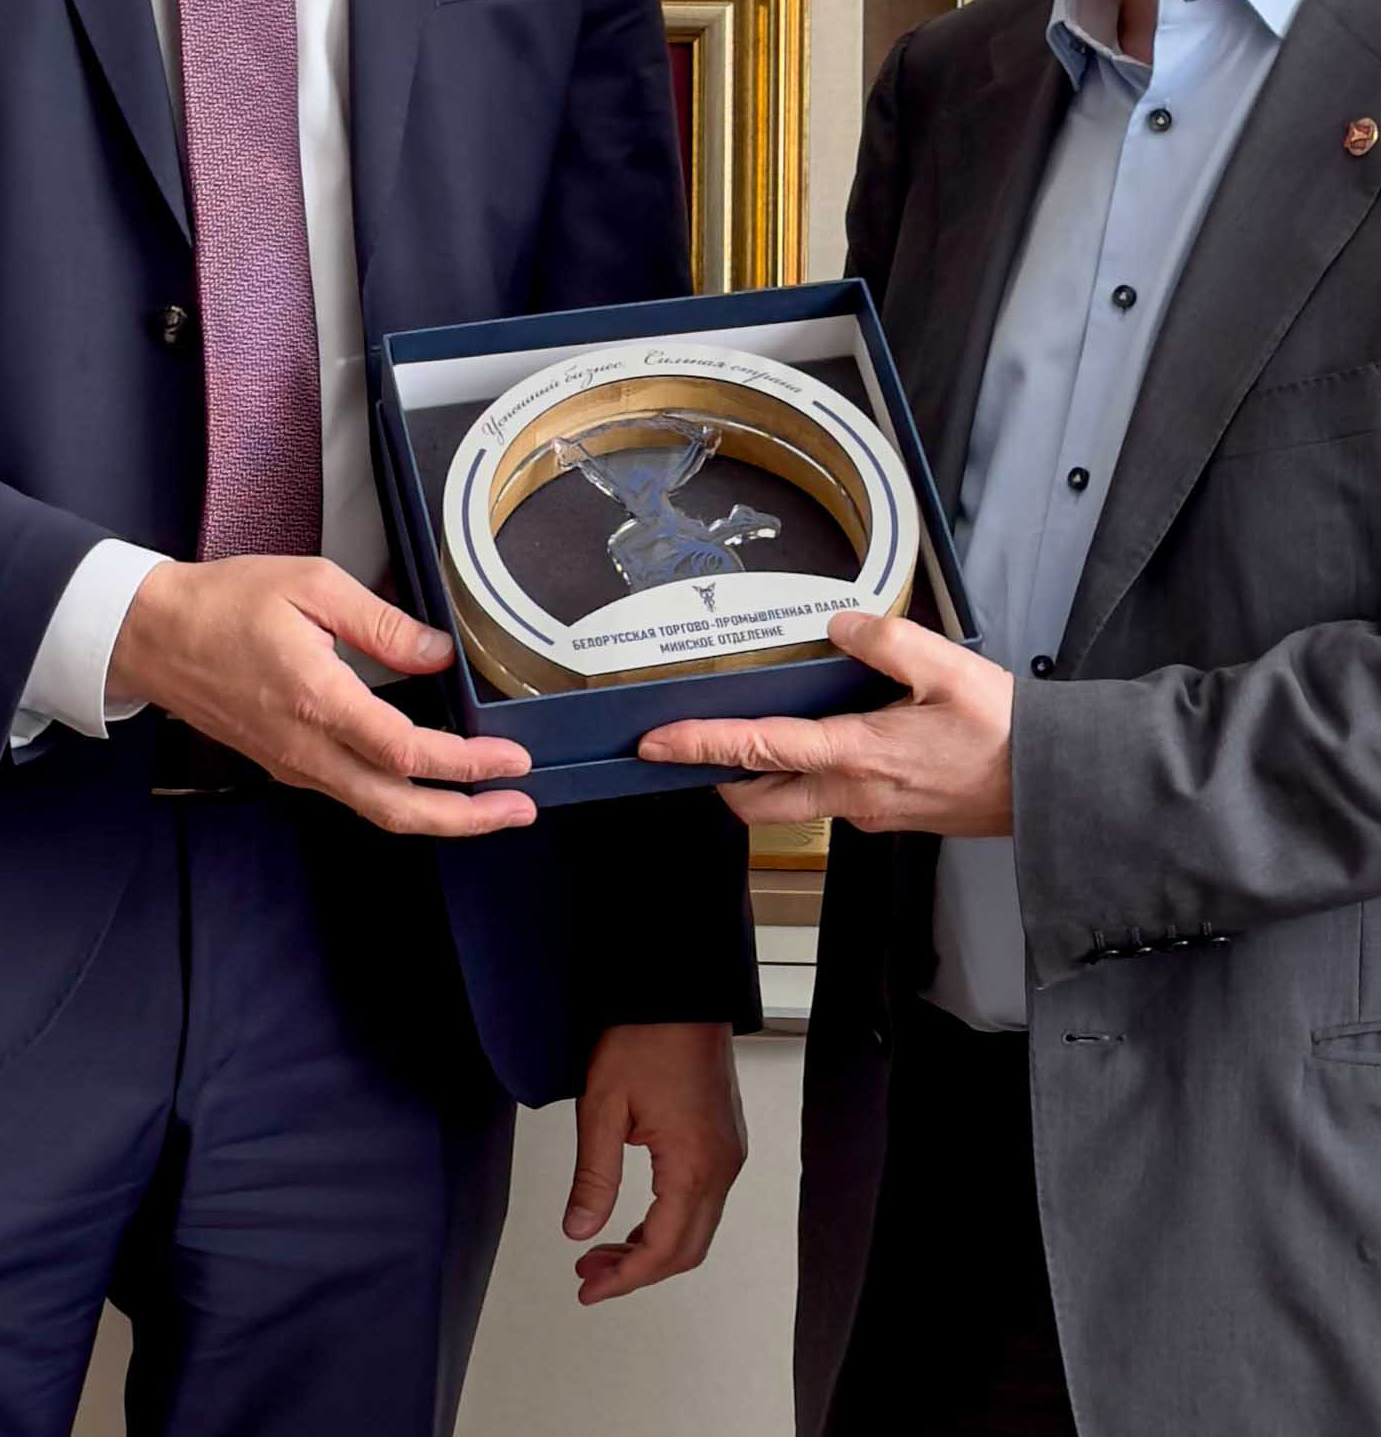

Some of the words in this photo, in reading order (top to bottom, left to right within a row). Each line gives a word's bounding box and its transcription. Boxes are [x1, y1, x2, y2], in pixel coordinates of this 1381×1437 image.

[571, 628, 657, 652] БЕЛОРУССКАЯ
[659, 604, 813, 638] ТОРГОВО-ПРОМЫШЛЕННАЯ
[814, 597, 860, 613] ПАЛАТА
[660, 637, 715, 654] МИНСКОЕ
[719, 625, 785, 646] ОТДЕЛЕНИЕ
